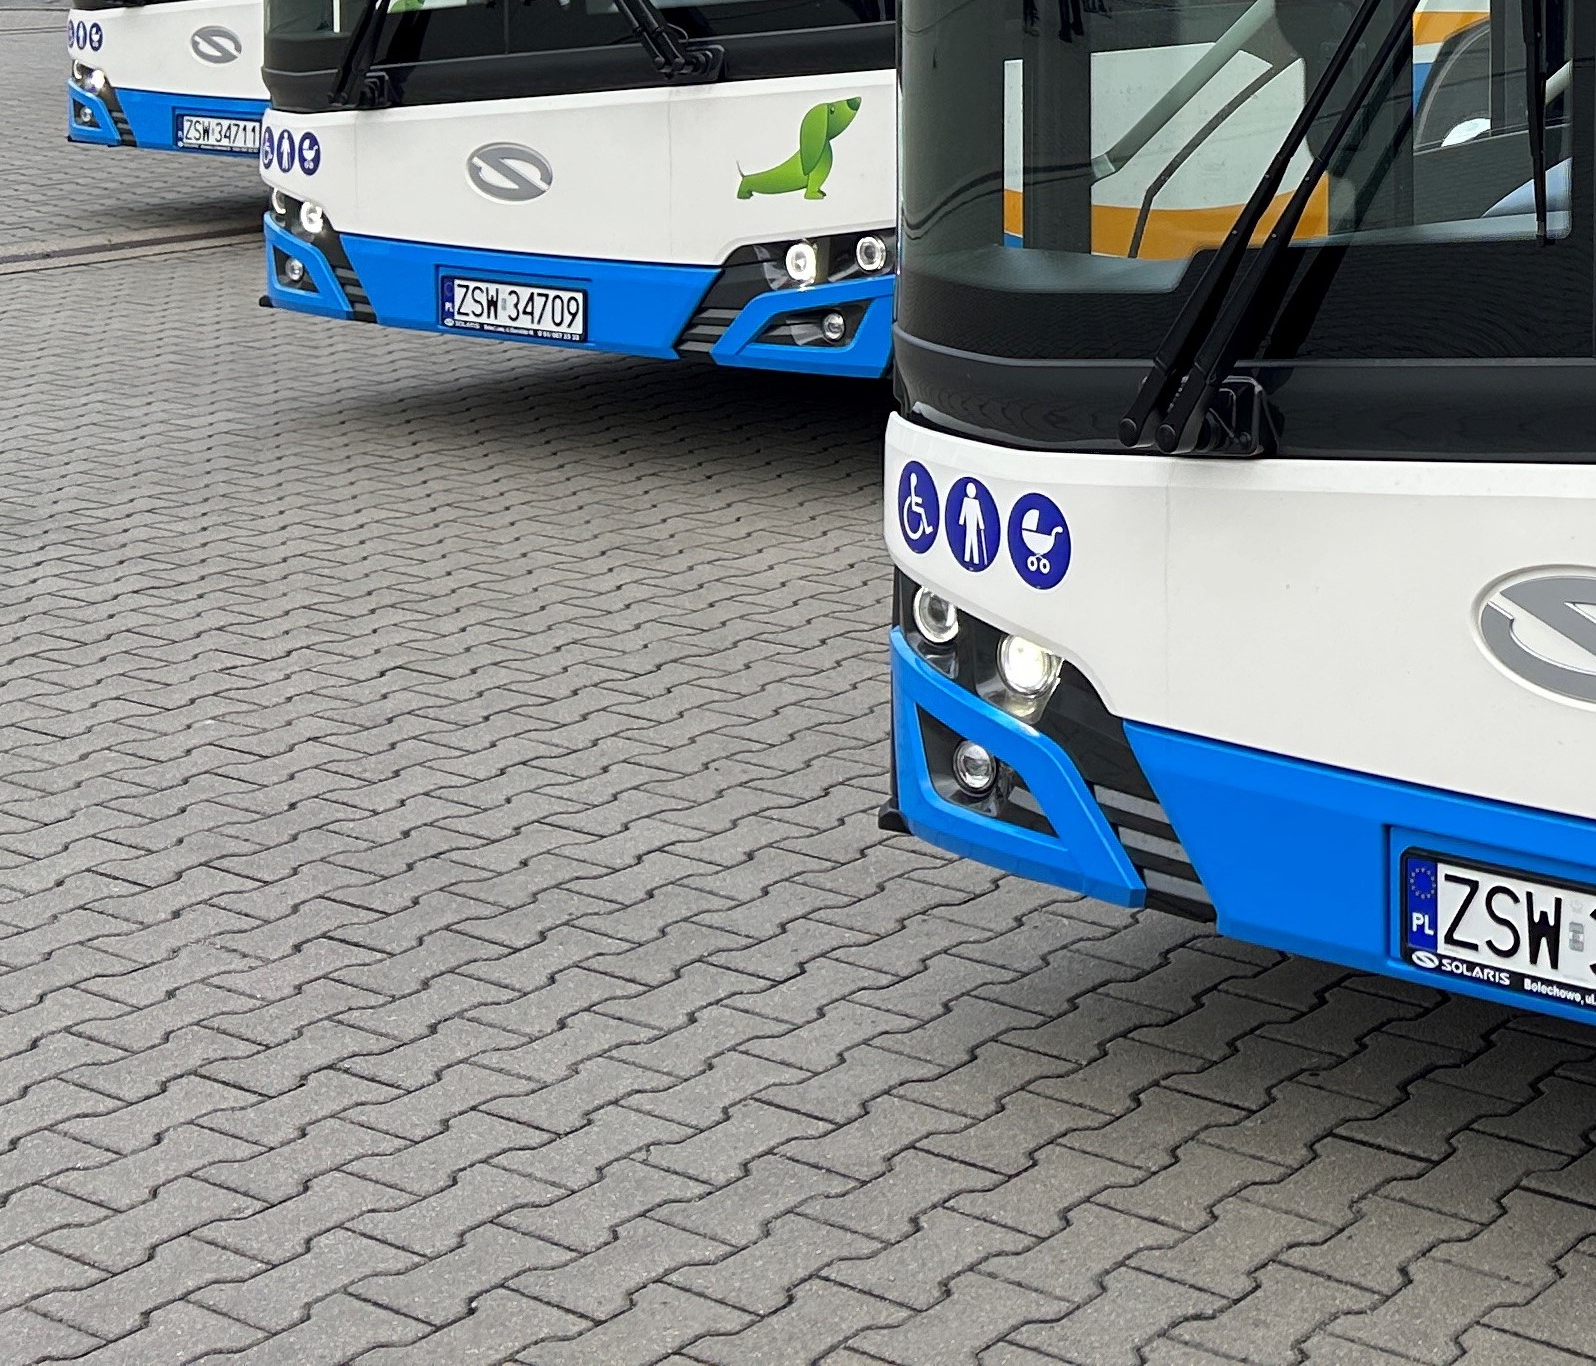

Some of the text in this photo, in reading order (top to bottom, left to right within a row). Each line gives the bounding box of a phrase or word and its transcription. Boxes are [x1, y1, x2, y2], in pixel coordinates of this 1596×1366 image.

[184, 118, 257, 147] ZSW 34711
[456, 283, 580, 329] ZSW 34709
[1412, 911, 1434, 937] PL
[1443, 872, 1563, 971] ZSW
[1441, 958, 1511, 986] SOLARIS
[1523, 978, 1585, 1006] Bolechowo,
